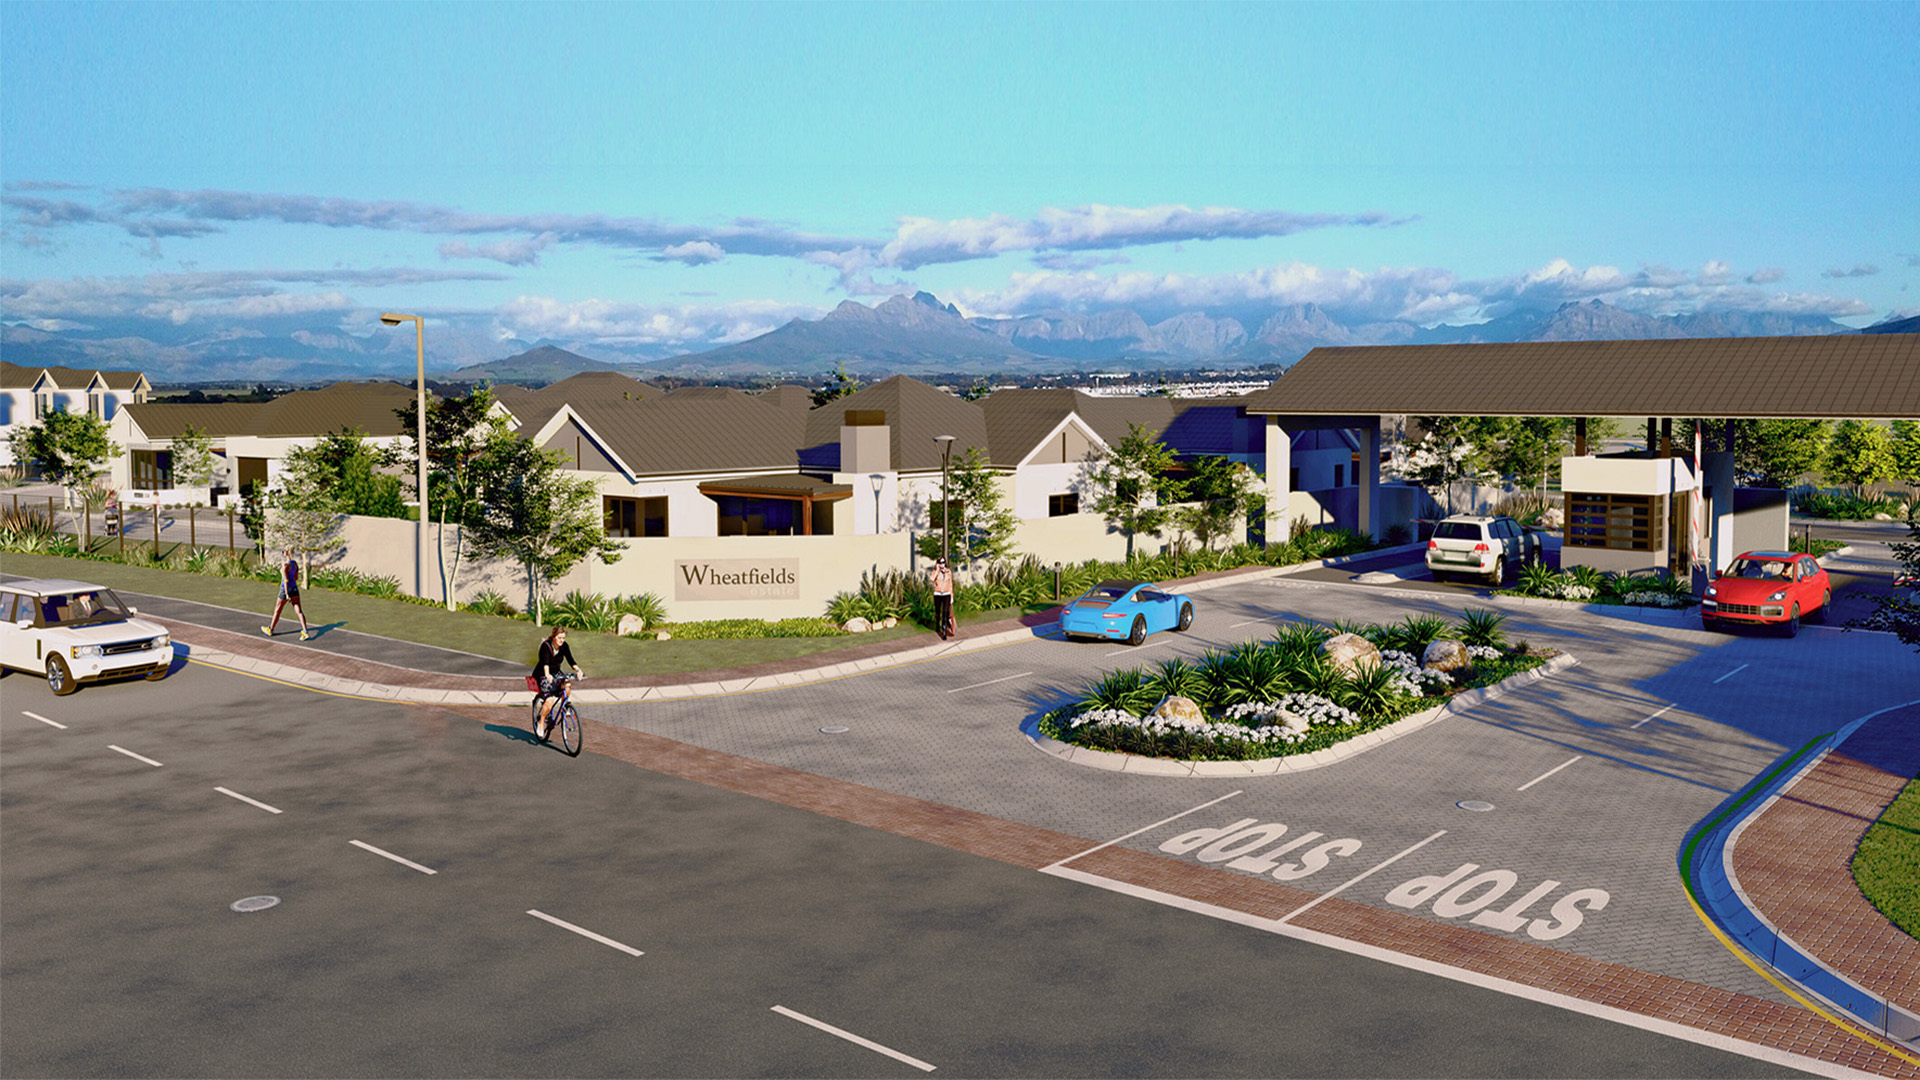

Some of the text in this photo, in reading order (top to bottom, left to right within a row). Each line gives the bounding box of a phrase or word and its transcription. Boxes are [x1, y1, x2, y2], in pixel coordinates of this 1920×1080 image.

[680, 564, 796, 586] Wheatfields
[1157, 817, 1363, 881] STOP
[1384, 862, 1611, 941] STOP
